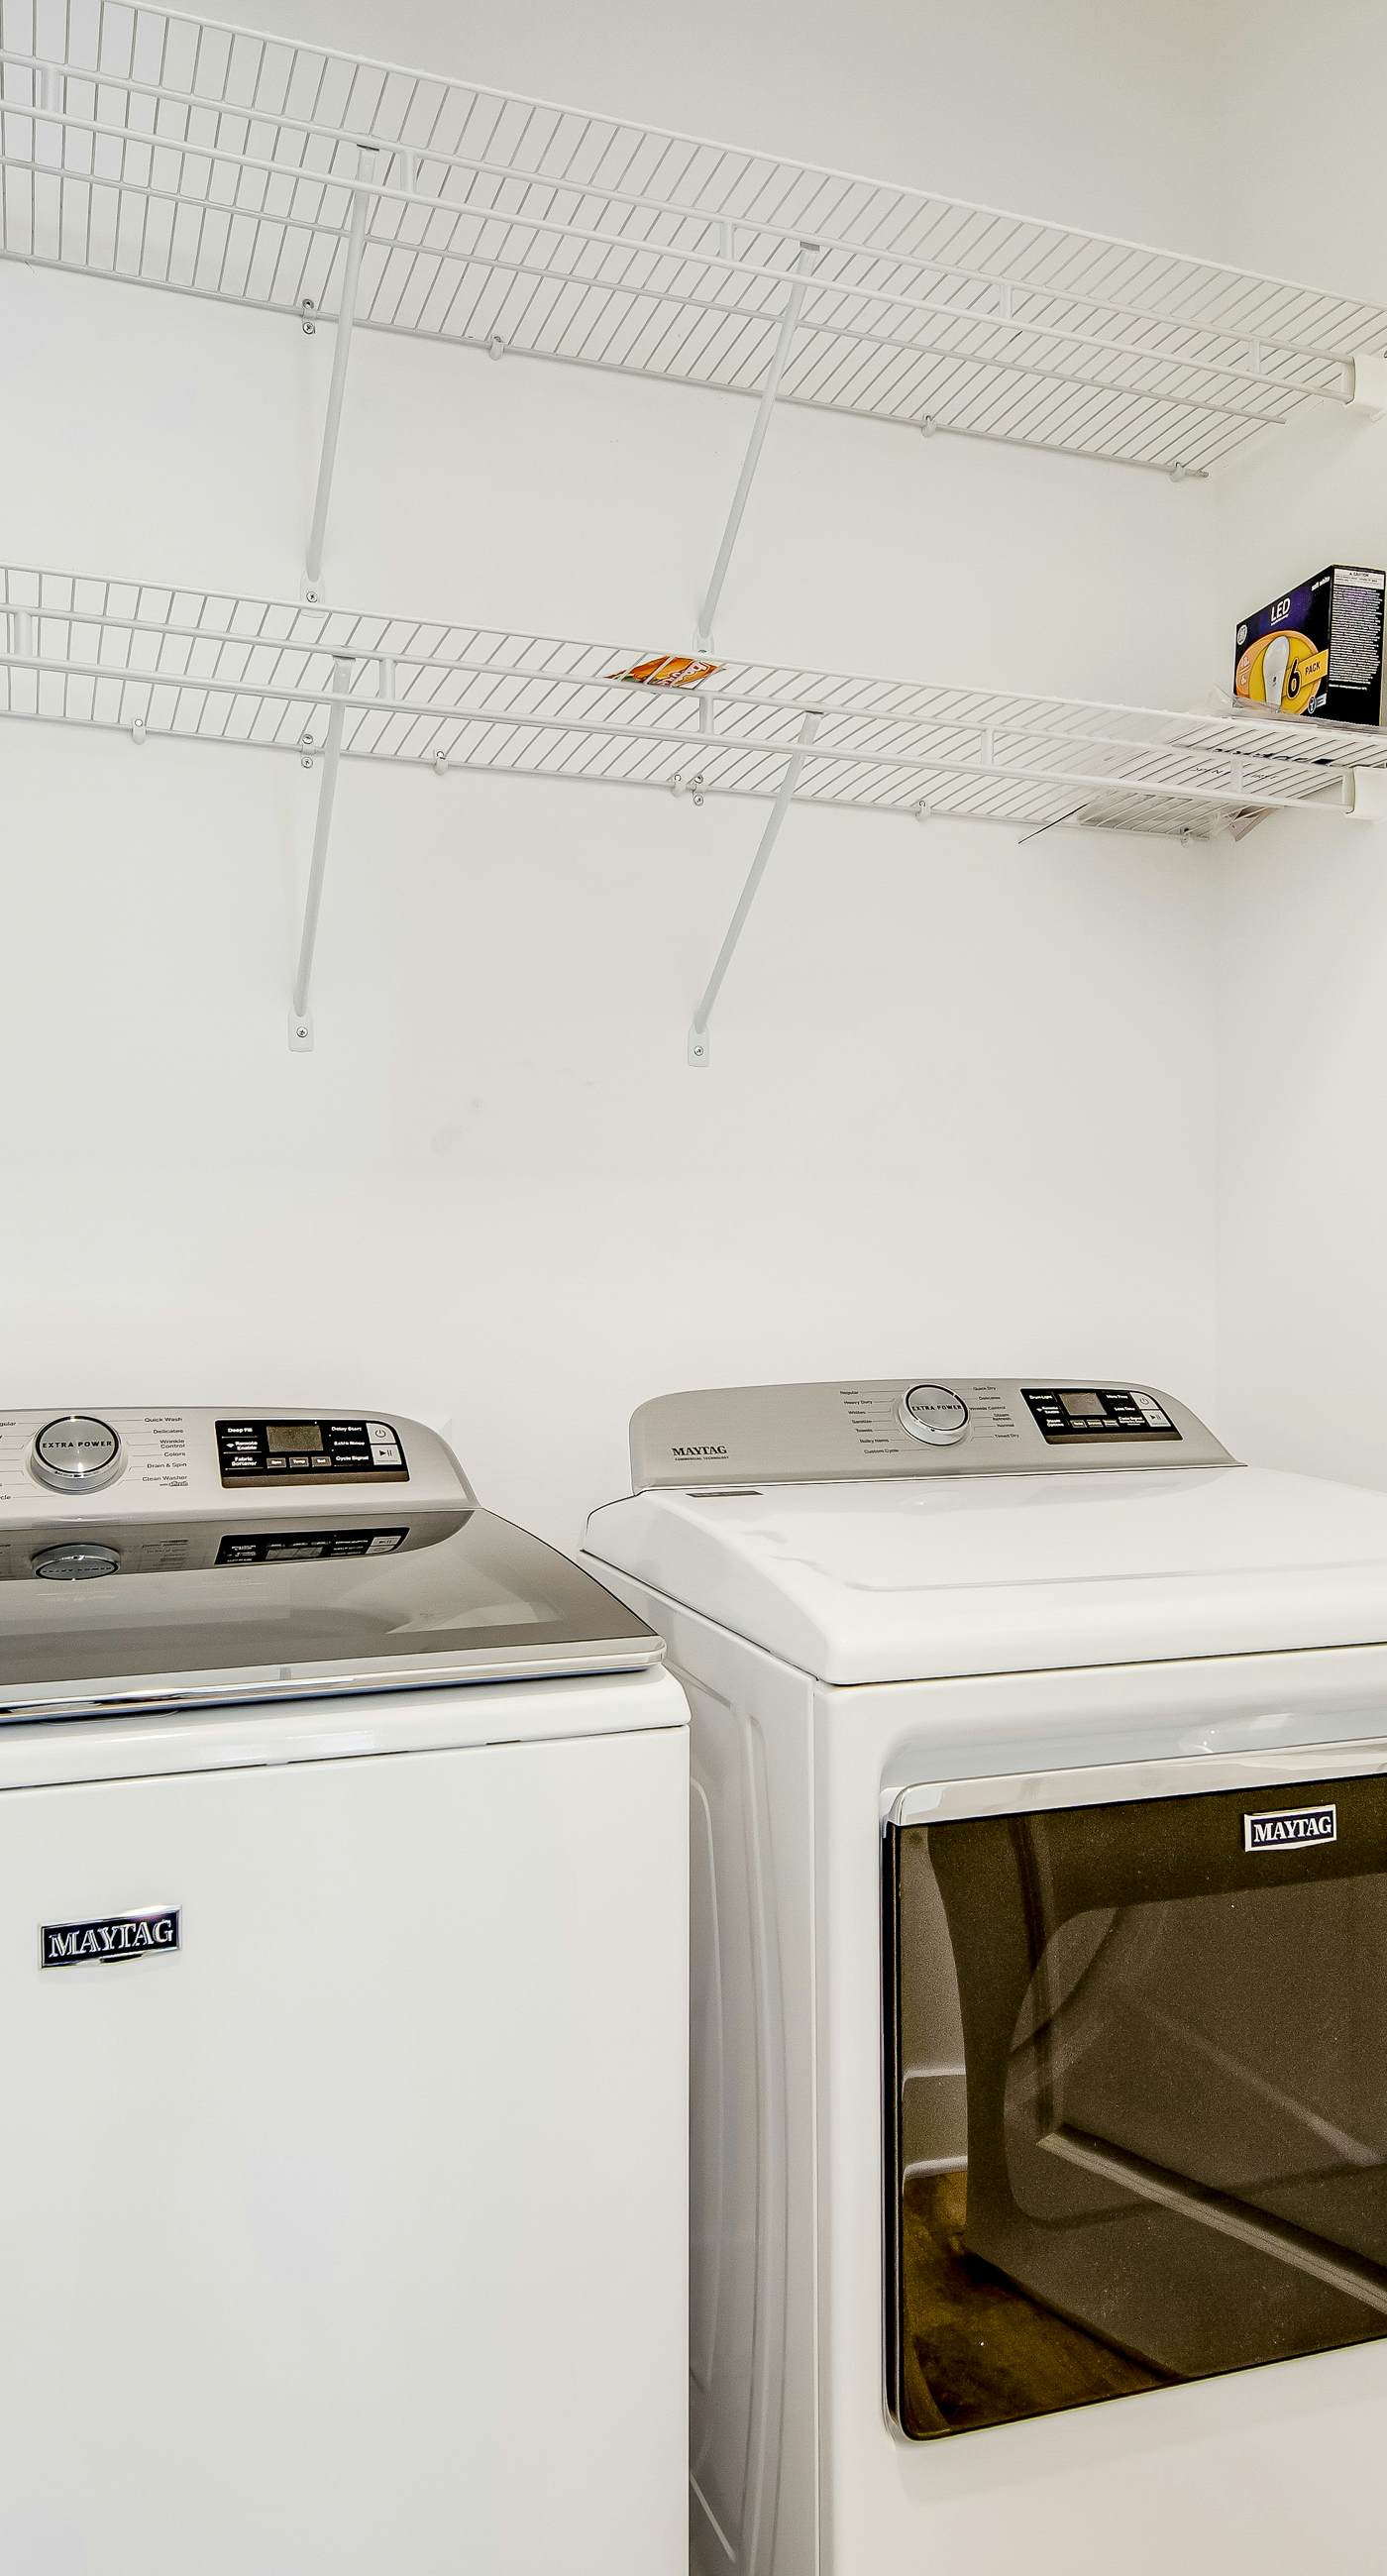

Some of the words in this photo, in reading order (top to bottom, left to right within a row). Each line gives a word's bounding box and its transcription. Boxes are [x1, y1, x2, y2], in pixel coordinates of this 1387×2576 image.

[1271, 597, 1291, 622] LED
[1288, 658, 1301, 698] 6
[1305, 661, 1321, 676] PACK
[77, 1440, 113, 1449] POWER
[672, 1446, 727, 1456] MAYTAG
[1253, 1816, 1333, 1843] MAYTAG
[49, 1919, 174, 1958] MAYTAG
